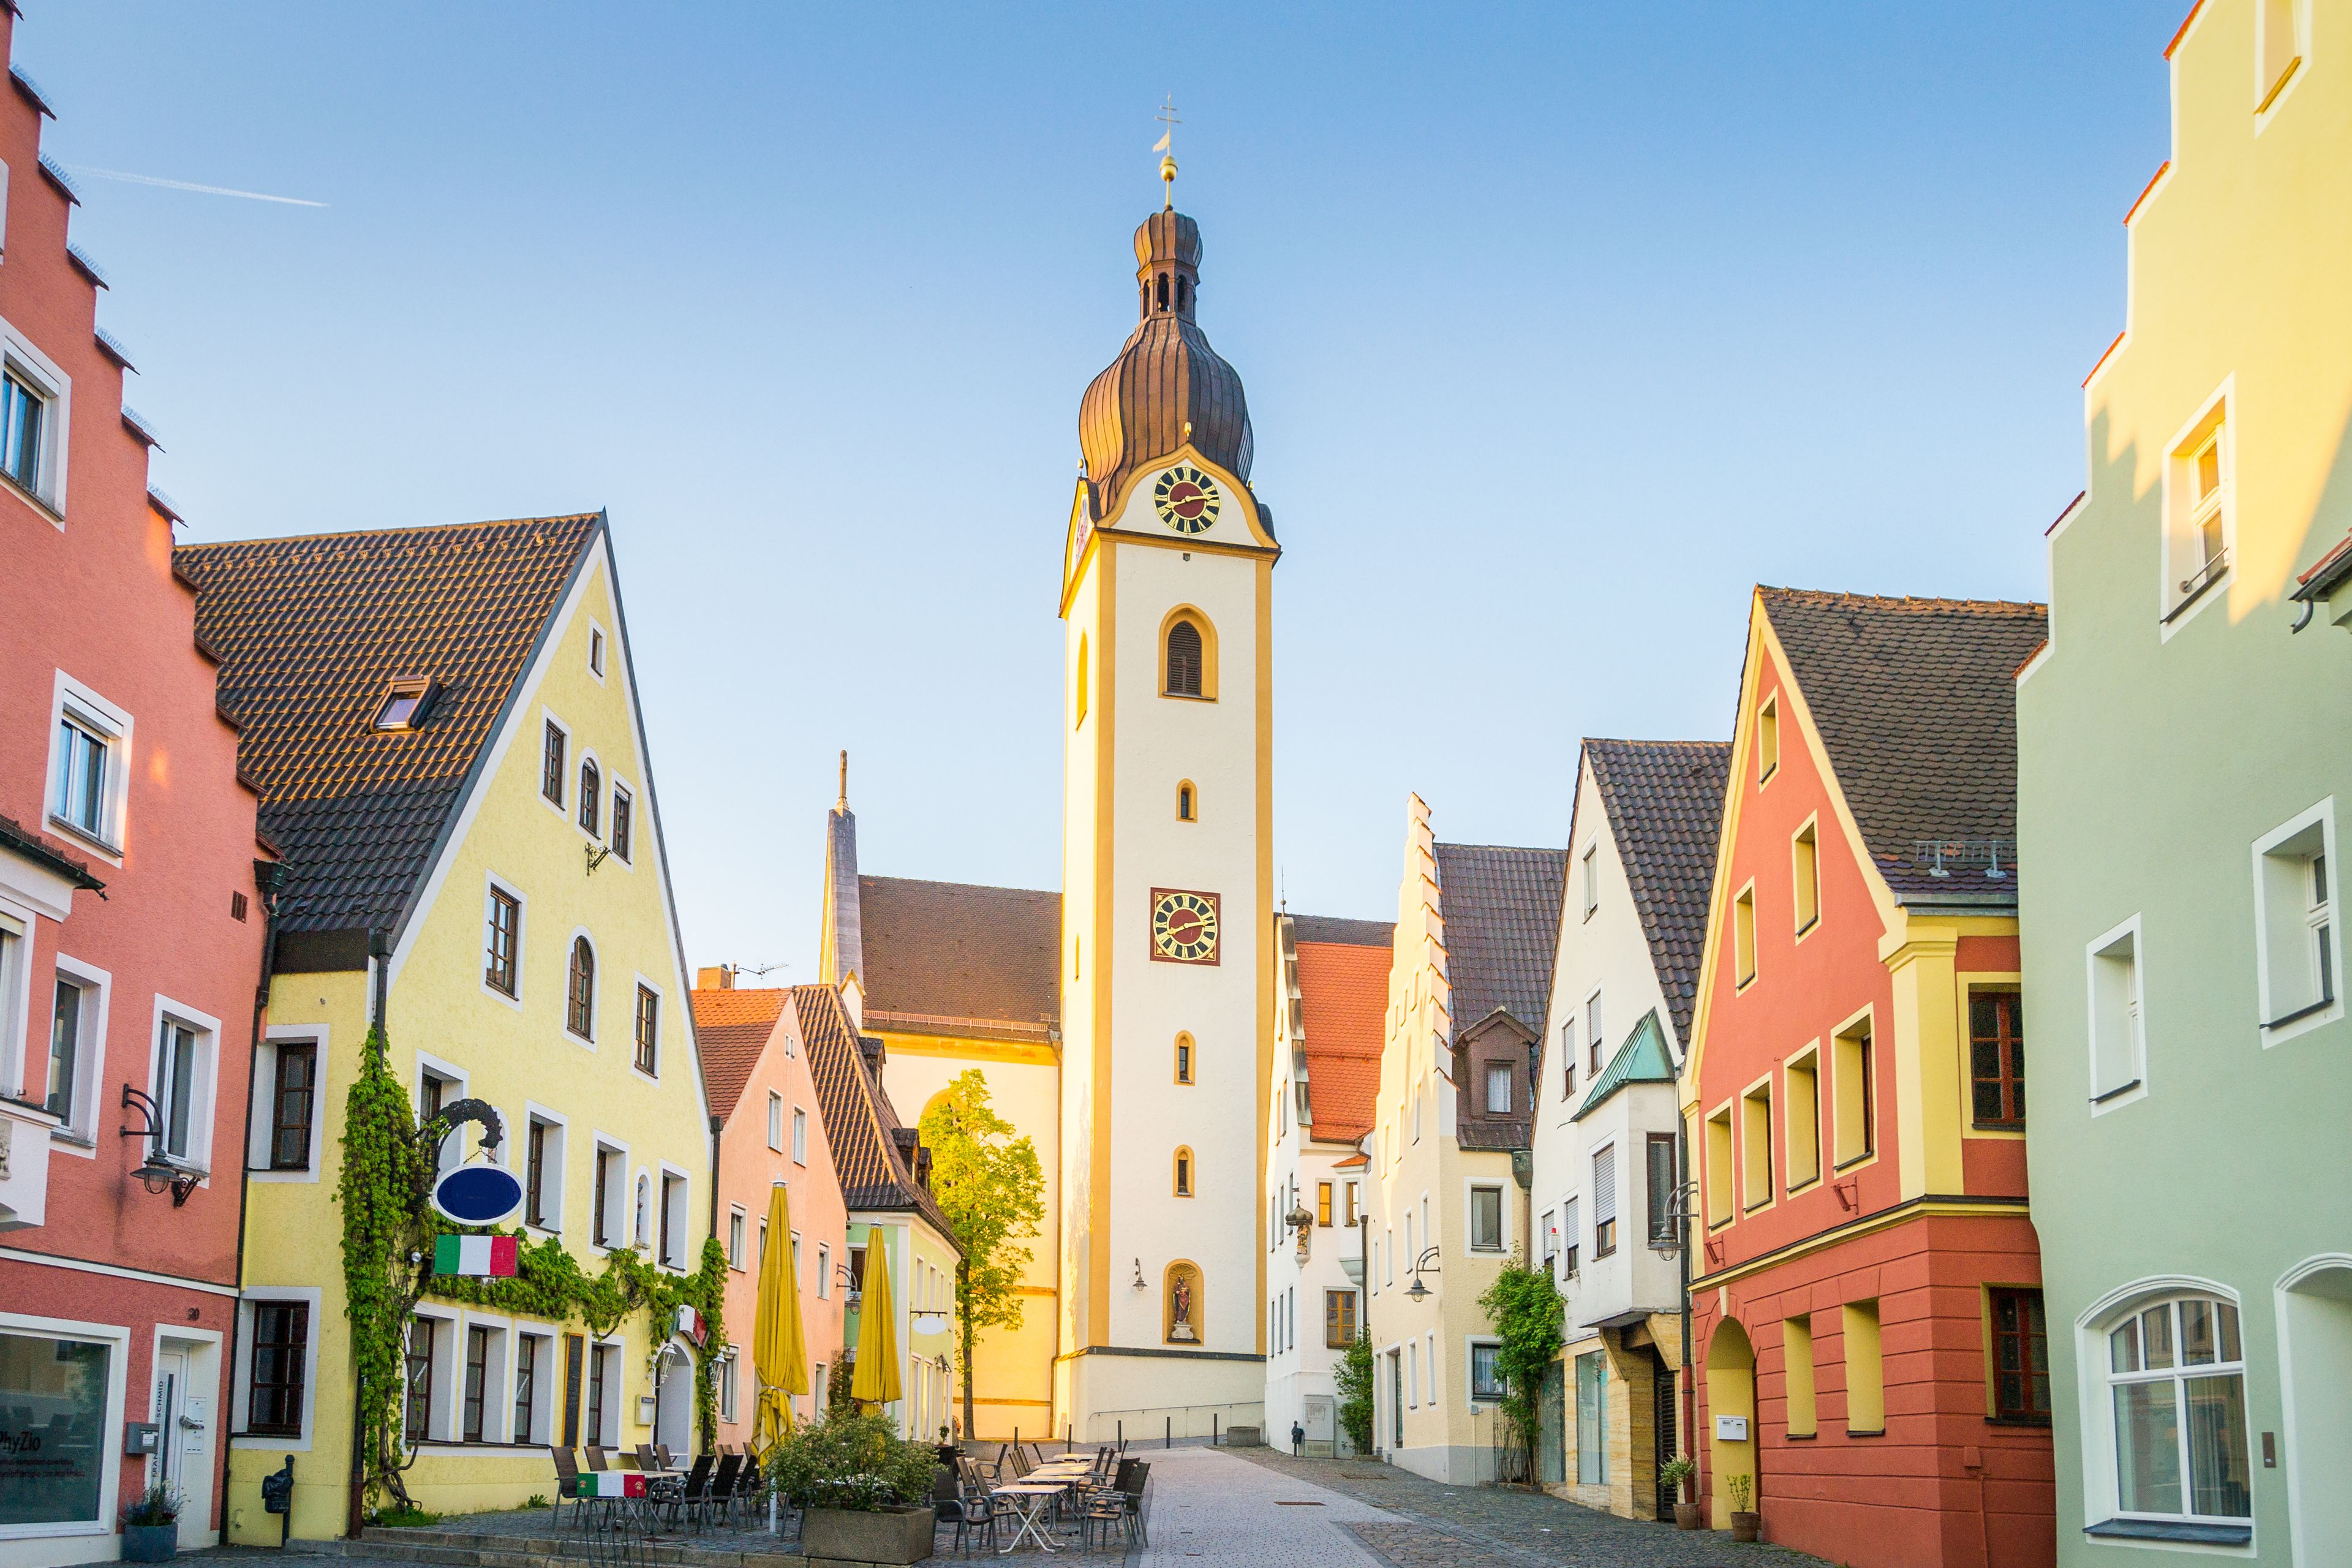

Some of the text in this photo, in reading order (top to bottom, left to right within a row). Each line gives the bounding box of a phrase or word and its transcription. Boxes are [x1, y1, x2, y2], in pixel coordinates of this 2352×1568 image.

[1167, 469, 1180, 483] XI
[1182, 467, 1192, 481] XII
[1196, 473, 1204, 484] I
[1158, 479, 1171, 490] X
[1204, 484, 1216, 496] II
[1197, 519, 1206, 530] V
